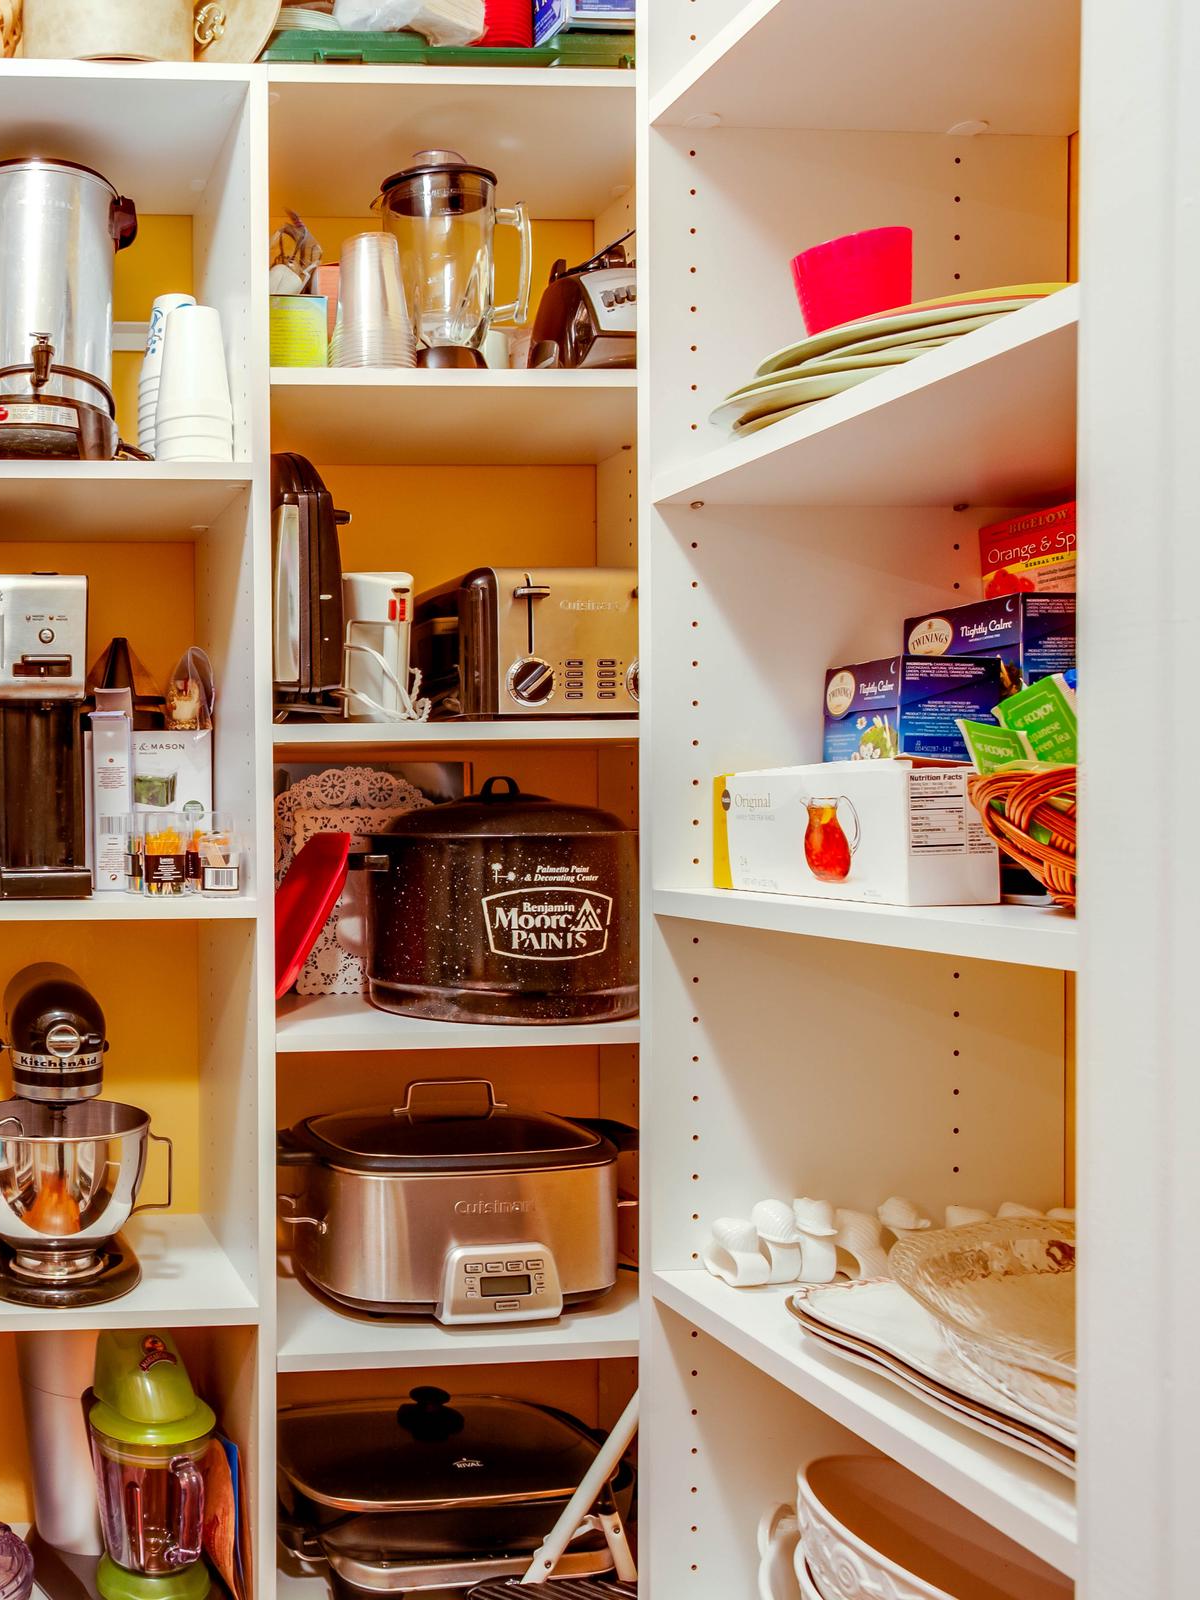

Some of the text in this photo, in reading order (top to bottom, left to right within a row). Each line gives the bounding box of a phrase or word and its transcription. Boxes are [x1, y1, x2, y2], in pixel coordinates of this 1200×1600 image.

[1008, 508, 1068, 534] BIGELOW
[987, 543, 1037, 564] Orange
[1040, 535, 1052, 552] &
[959, 625, 988, 638] Nightly
[911, 632, 950, 651] TWININGS
[909, 774, 941, 782] Nutrition
[734, 792, 771, 813] Original
[536, 865, 590, 874] Palmetto Paint
[523, 873, 599, 884] & Decorating Center
[522, 902, 575, 915] Benjamin
[20, 1055, 98, 1068] KitchenAid
[456, 1460, 485, 1469] RIVAL
